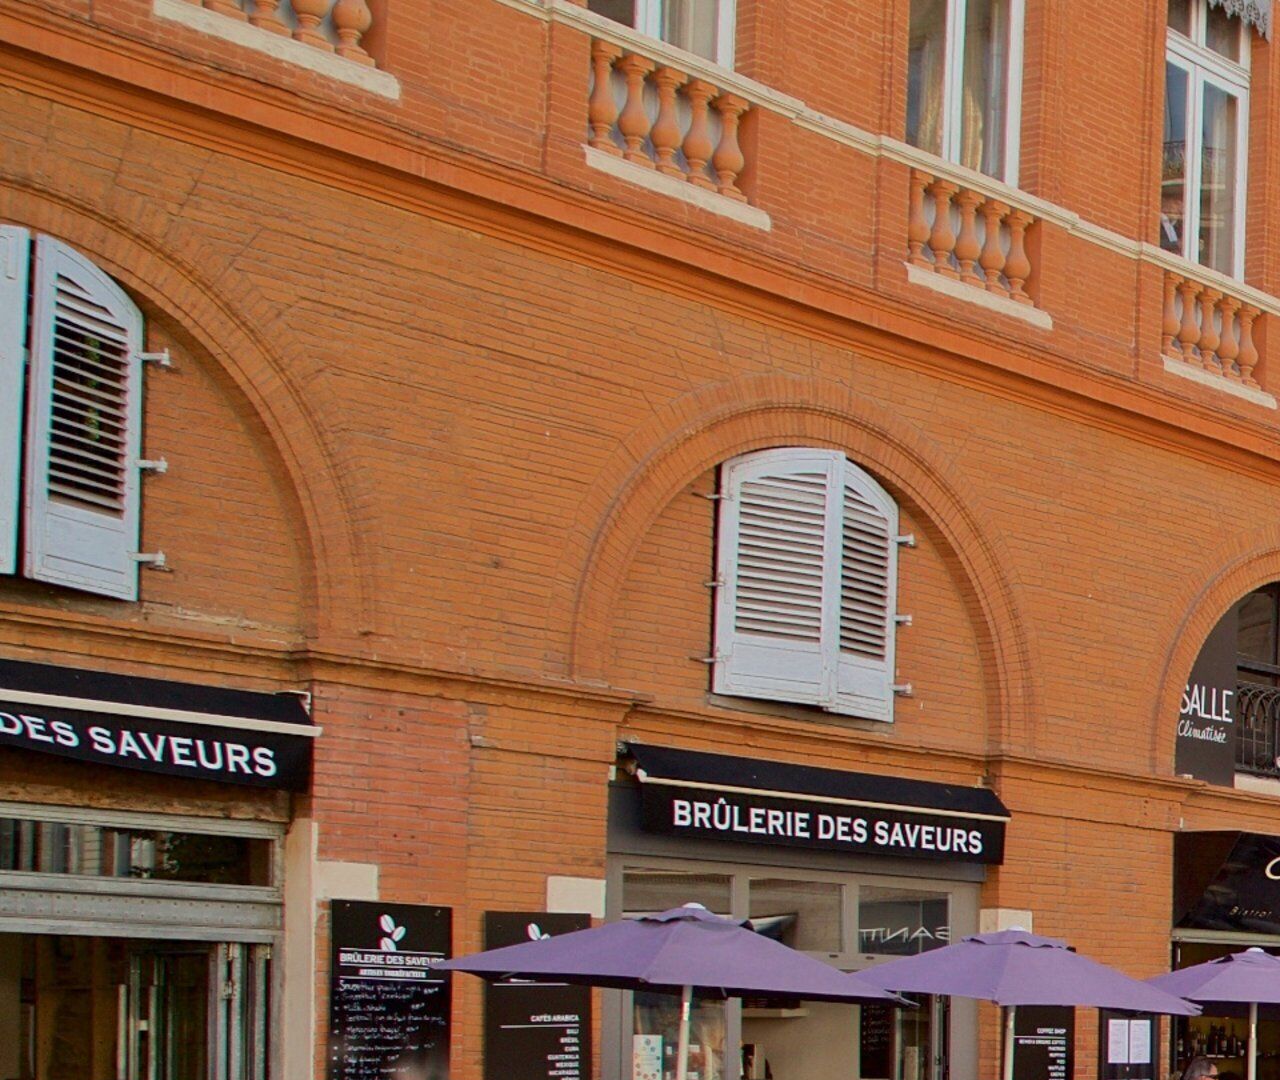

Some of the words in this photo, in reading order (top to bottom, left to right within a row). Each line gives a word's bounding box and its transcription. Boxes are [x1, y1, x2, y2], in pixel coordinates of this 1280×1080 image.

[1179, 684, 1234, 723] SALLE
[0, 712, 80, 748] DES
[88, 726, 278, 777] SAVEURS
[672, 797, 810, 838] BRÛLERIE
[817, 814, 867, 843] DES
[874, 820, 983, 855] SAVEURS
[386, 955, 404, 965] DES
